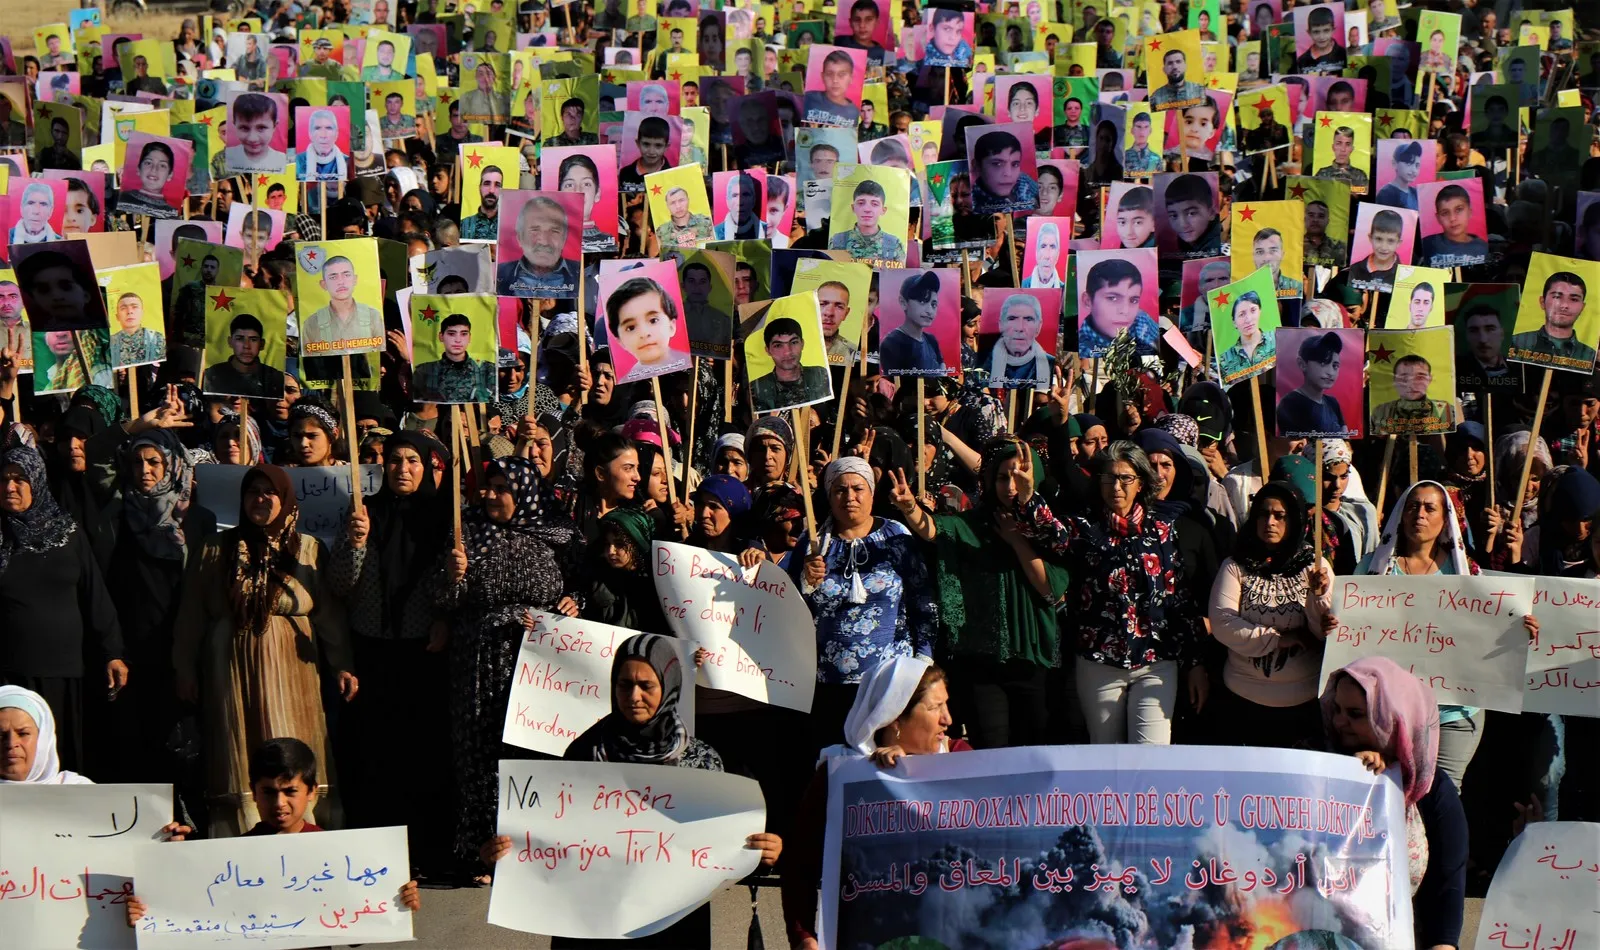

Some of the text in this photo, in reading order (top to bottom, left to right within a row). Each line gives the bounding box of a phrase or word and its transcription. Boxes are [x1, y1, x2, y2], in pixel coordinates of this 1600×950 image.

[657, 547, 676, 577] Bi
[754, 604, 767, 635] li
[1527, 667, 1569, 691] الكرد
[507, 775, 542, 810] Na
[555, 783, 573, 818] ji
[936, 793, 1030, 831] ERDOXAN
[1135, 786, 1158, 827] BÊ
[1163, 785, 1203, 828] SÛC
[1212, 786, 1231, 828] Û
[1239, 794, 1312, 831] GUNEH
[88, 796, 138, 838] لا
[517, 830, 611, 871] dagiriya
[207, 855, 389, 907] مهما غيروا معالم
[841, 863, 929, 902] والمسن
[939, 857, 1021, 892] المعاق
[1032, 862, 1075, 894] بين
[1083, 862, 1138, 895] يميز
[1149, 856, 1173, 885] لا
[1185, 852, 1307, 895] أردوغان
[319, 898, 389, 930] عفرين
